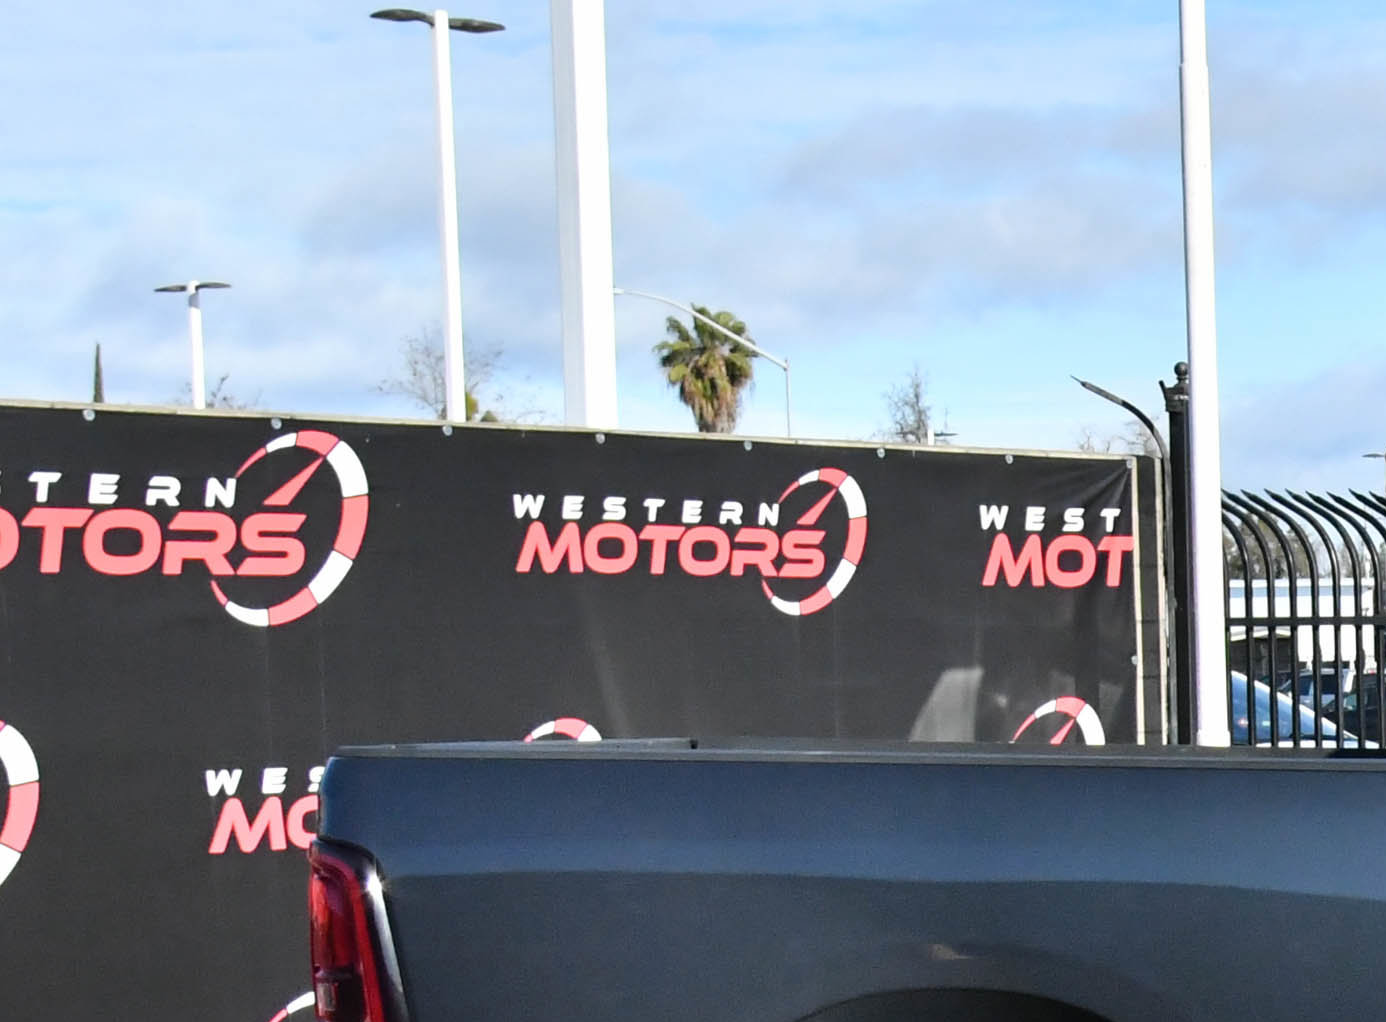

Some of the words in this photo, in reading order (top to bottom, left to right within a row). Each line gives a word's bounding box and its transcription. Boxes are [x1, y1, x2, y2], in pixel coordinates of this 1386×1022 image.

[0, 471, 237, 508] TERN
[512, 493, 781, 526] WESTERN
[0, 506, 307, 577] TORS
[979, 504, 1121, 533] WEST
[515, 521, 827, 578] MOTORS
[981, 532, 1135, 588] MOT
